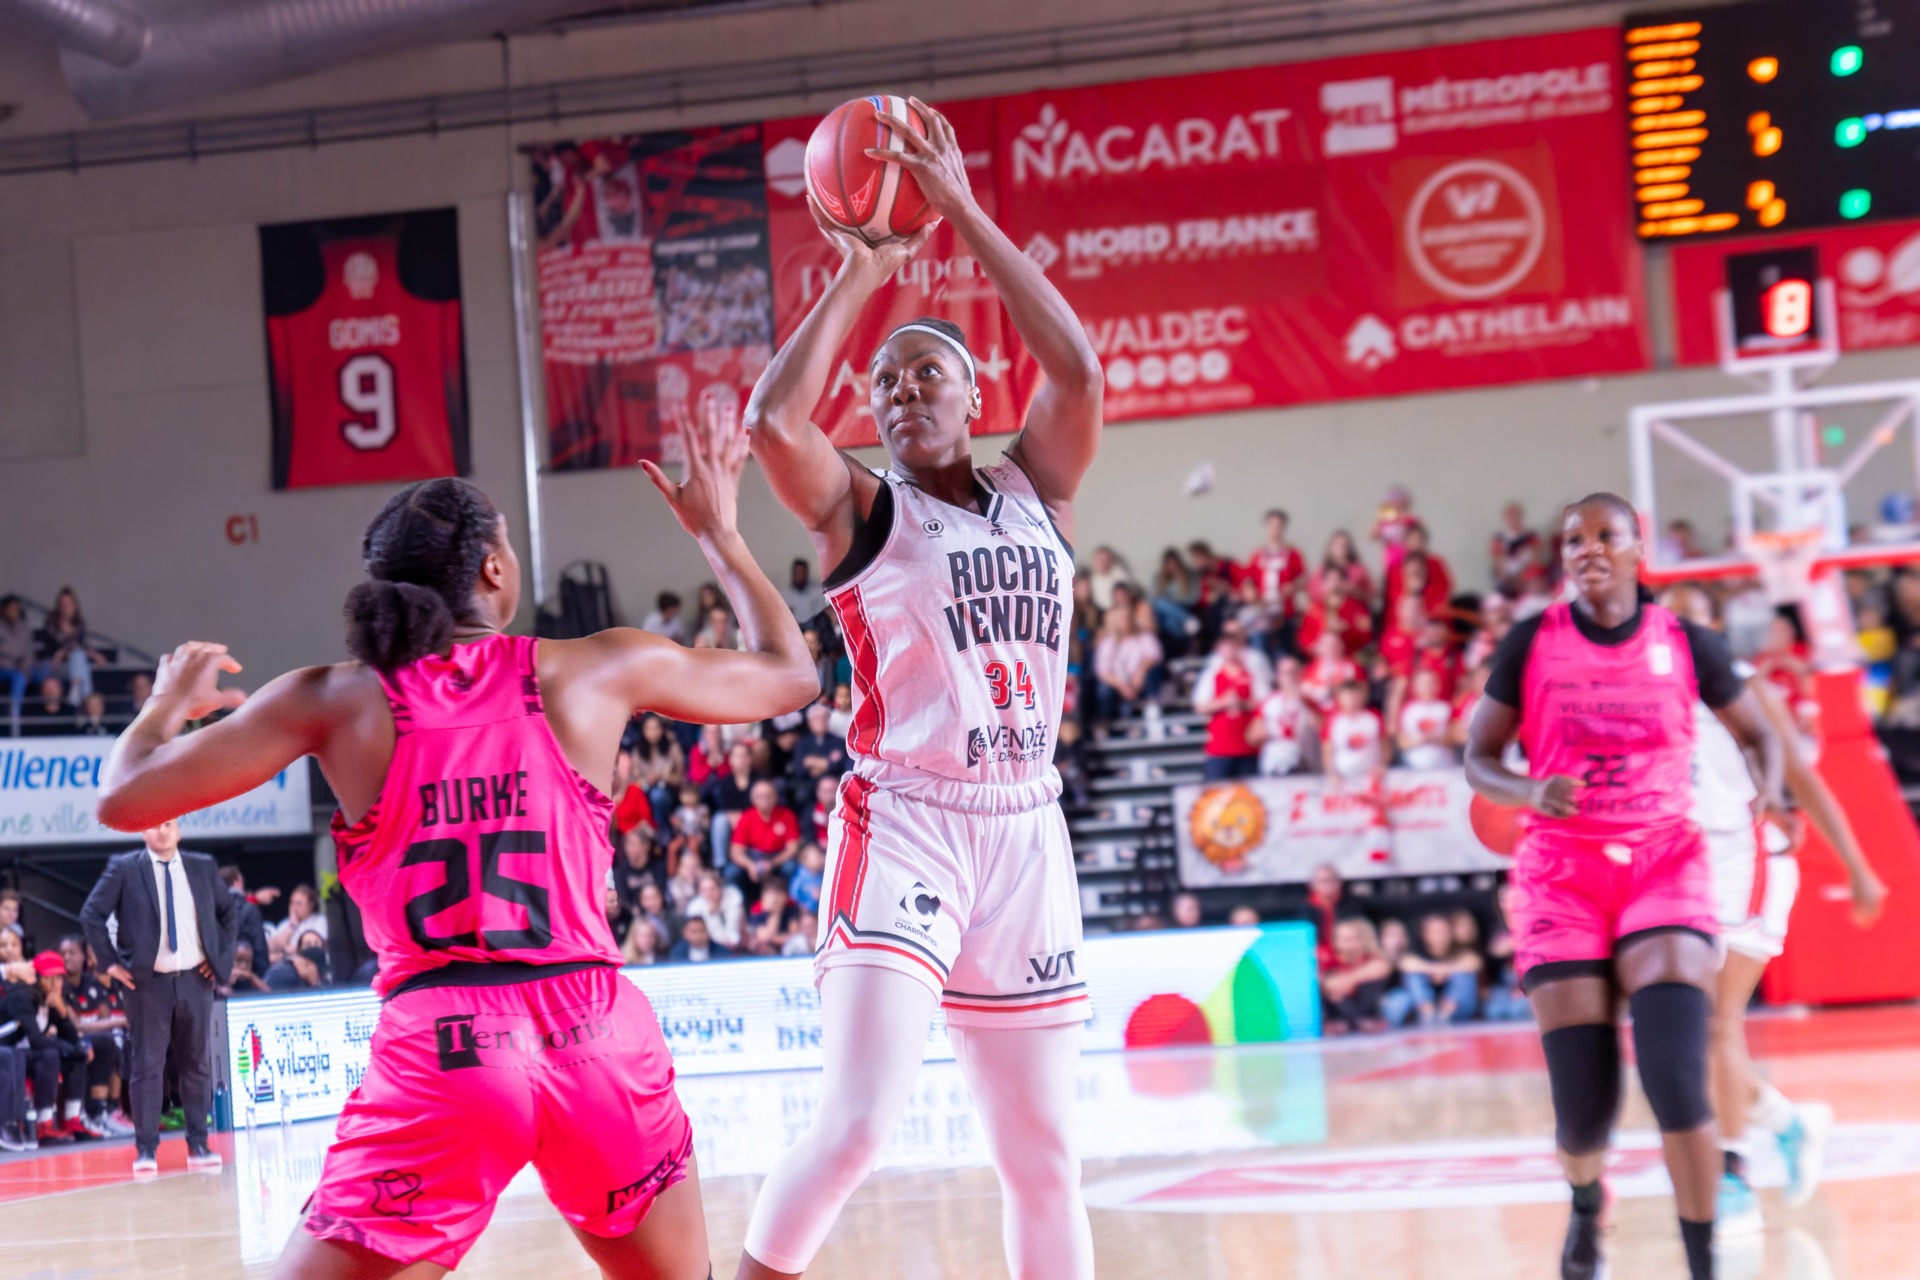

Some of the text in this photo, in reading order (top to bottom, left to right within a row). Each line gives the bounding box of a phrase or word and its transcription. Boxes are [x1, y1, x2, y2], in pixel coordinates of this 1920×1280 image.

[1401, 62, 1610, 113] MÉTROPOLE
[1011, 108, 1292, 184] NACARAT
[1064, 222, 1171, 260] NORD
[1176, 208, 1316, 252] FRANCE
[329, 315, 400, 351] GOMIS
[1402, 297, 1630, 350] CATHELAIN
[1763, 279, 1812, 338] 8
[339, 352, 397, 452] 9
[946, 545, 1060, 603] ROCHE
[984, 659, 1036, 710] 34
[986, 721, 1048, 750] VENDÉE
[1583, 754, 1627, 788] 22
[41, 803, 90, 834] ville
[419, 770, 529, 829] BURKE
[397, 830, 553, 951] 25
[438, 1014, 611, 1062] Temporis
